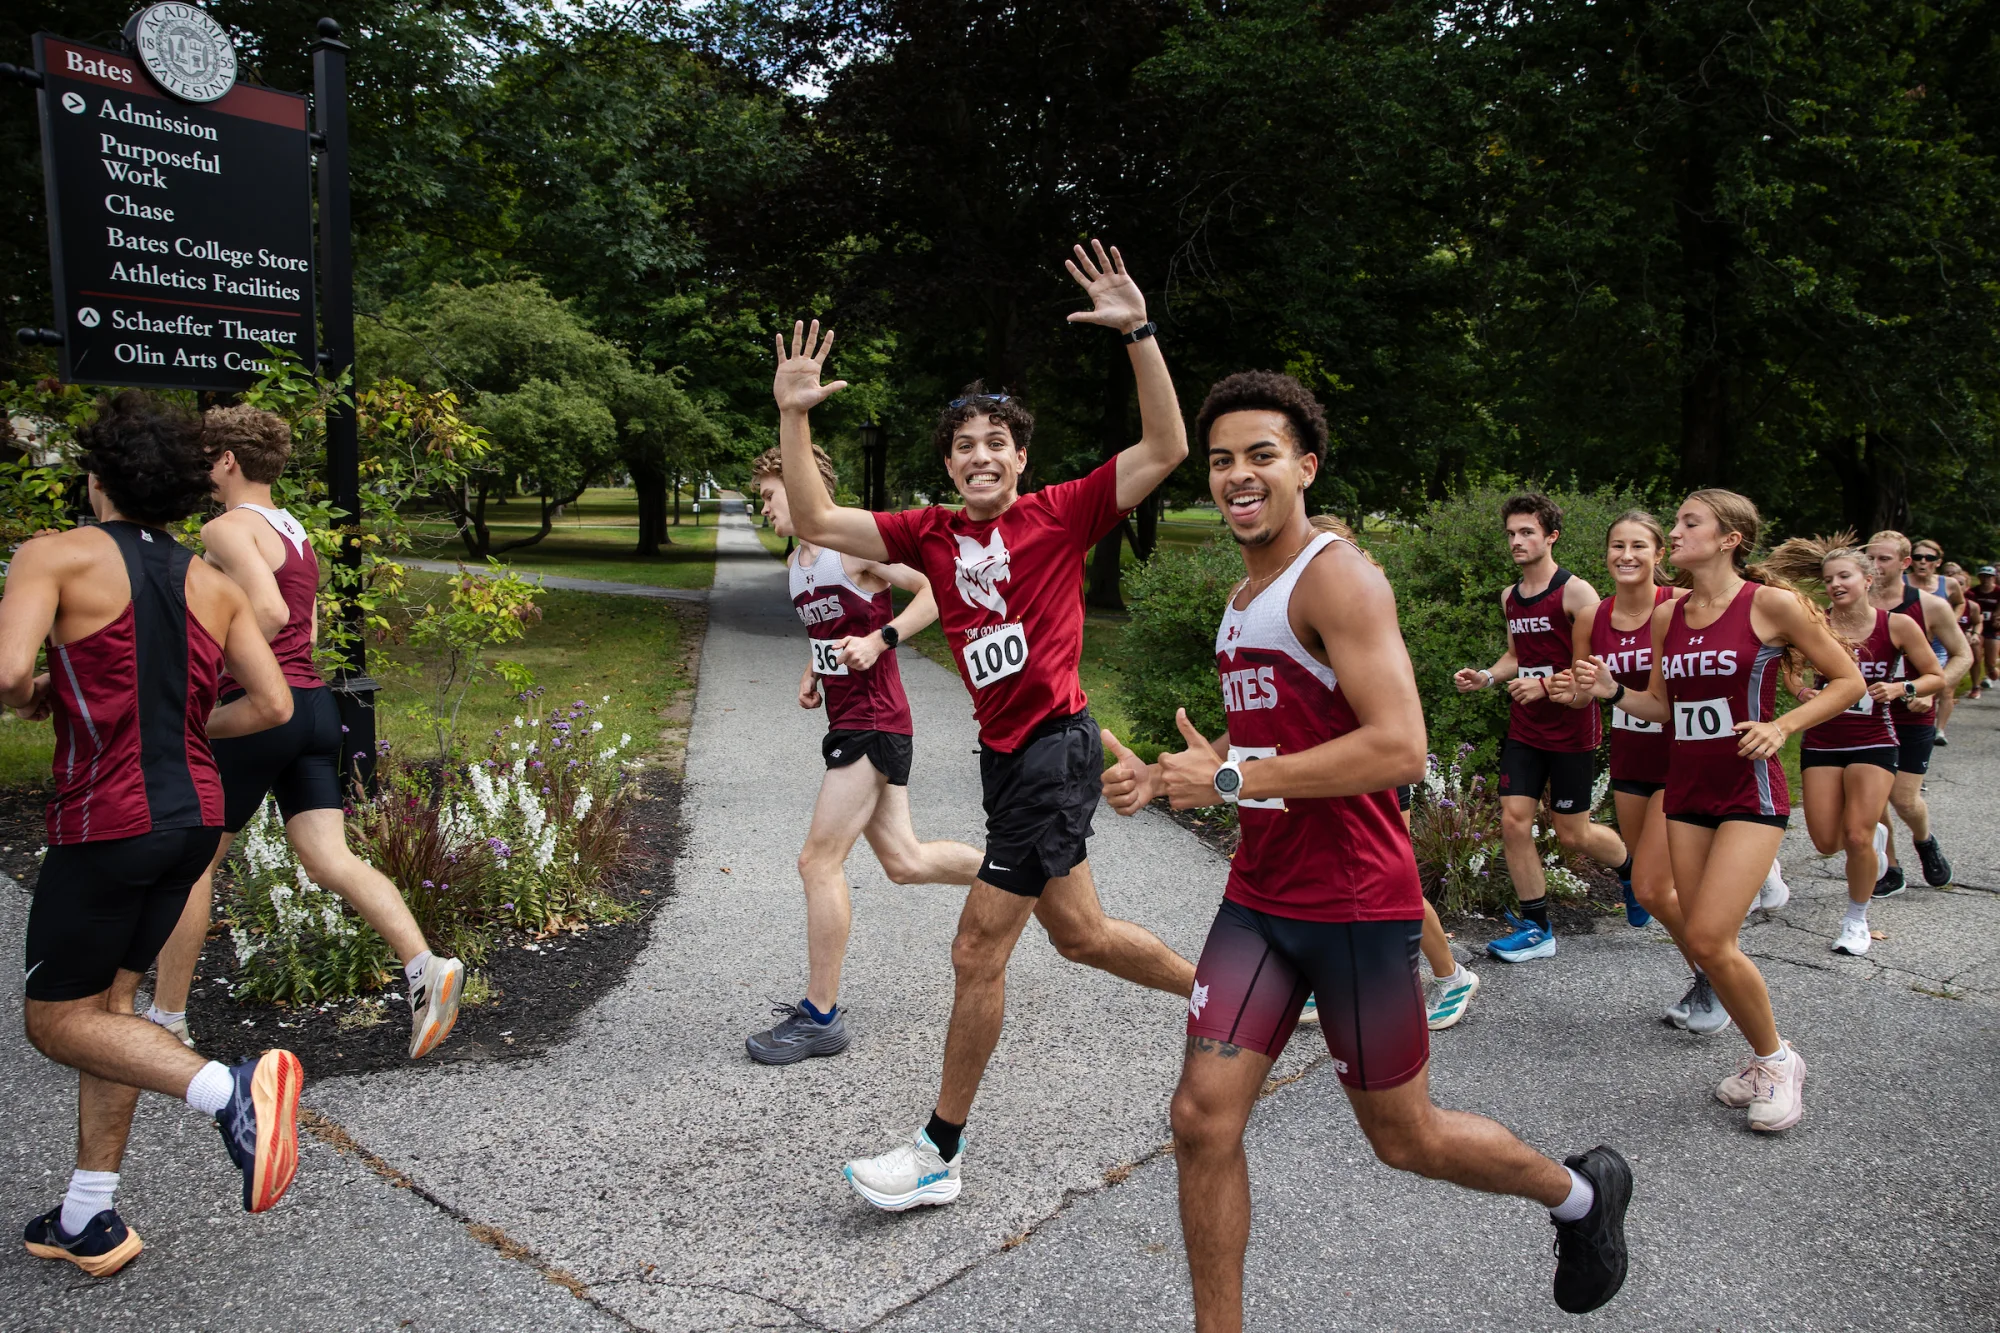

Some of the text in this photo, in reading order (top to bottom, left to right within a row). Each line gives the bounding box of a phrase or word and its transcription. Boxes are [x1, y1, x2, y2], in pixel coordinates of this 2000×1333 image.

[144, 6, 228, 52] ACADEMIA
[65, 50, 132, 84] Bates
[141, 36, 234, 69] 18 55
[147, 57, 231, 98] BATESINA
[98, 99, 218, 141] Admission
[100, 133, 221, 175] Purposeful
[101, 158, 168, 190] Work
[105, 193, 174, 222] Chase
[107, 227, 308, 272] Bates College Store
[110, 262, 300, 301] Athletics Facilities
[112, 310, 297, 344] Schaeffer Theater
[115, 343, 290, 373] Olin Arts Cent
[1509, 616, 1551, 634] BATES
[814, 643, 839, 671] 36
[970, 634, 1024, 682] 100
[1595, 648, 1652, 674] ATE
[1661, 649, 1738, 680] BATES
[1219, 666, 1278, 712] ATES
[1681, 705, 1721, 736] 70
